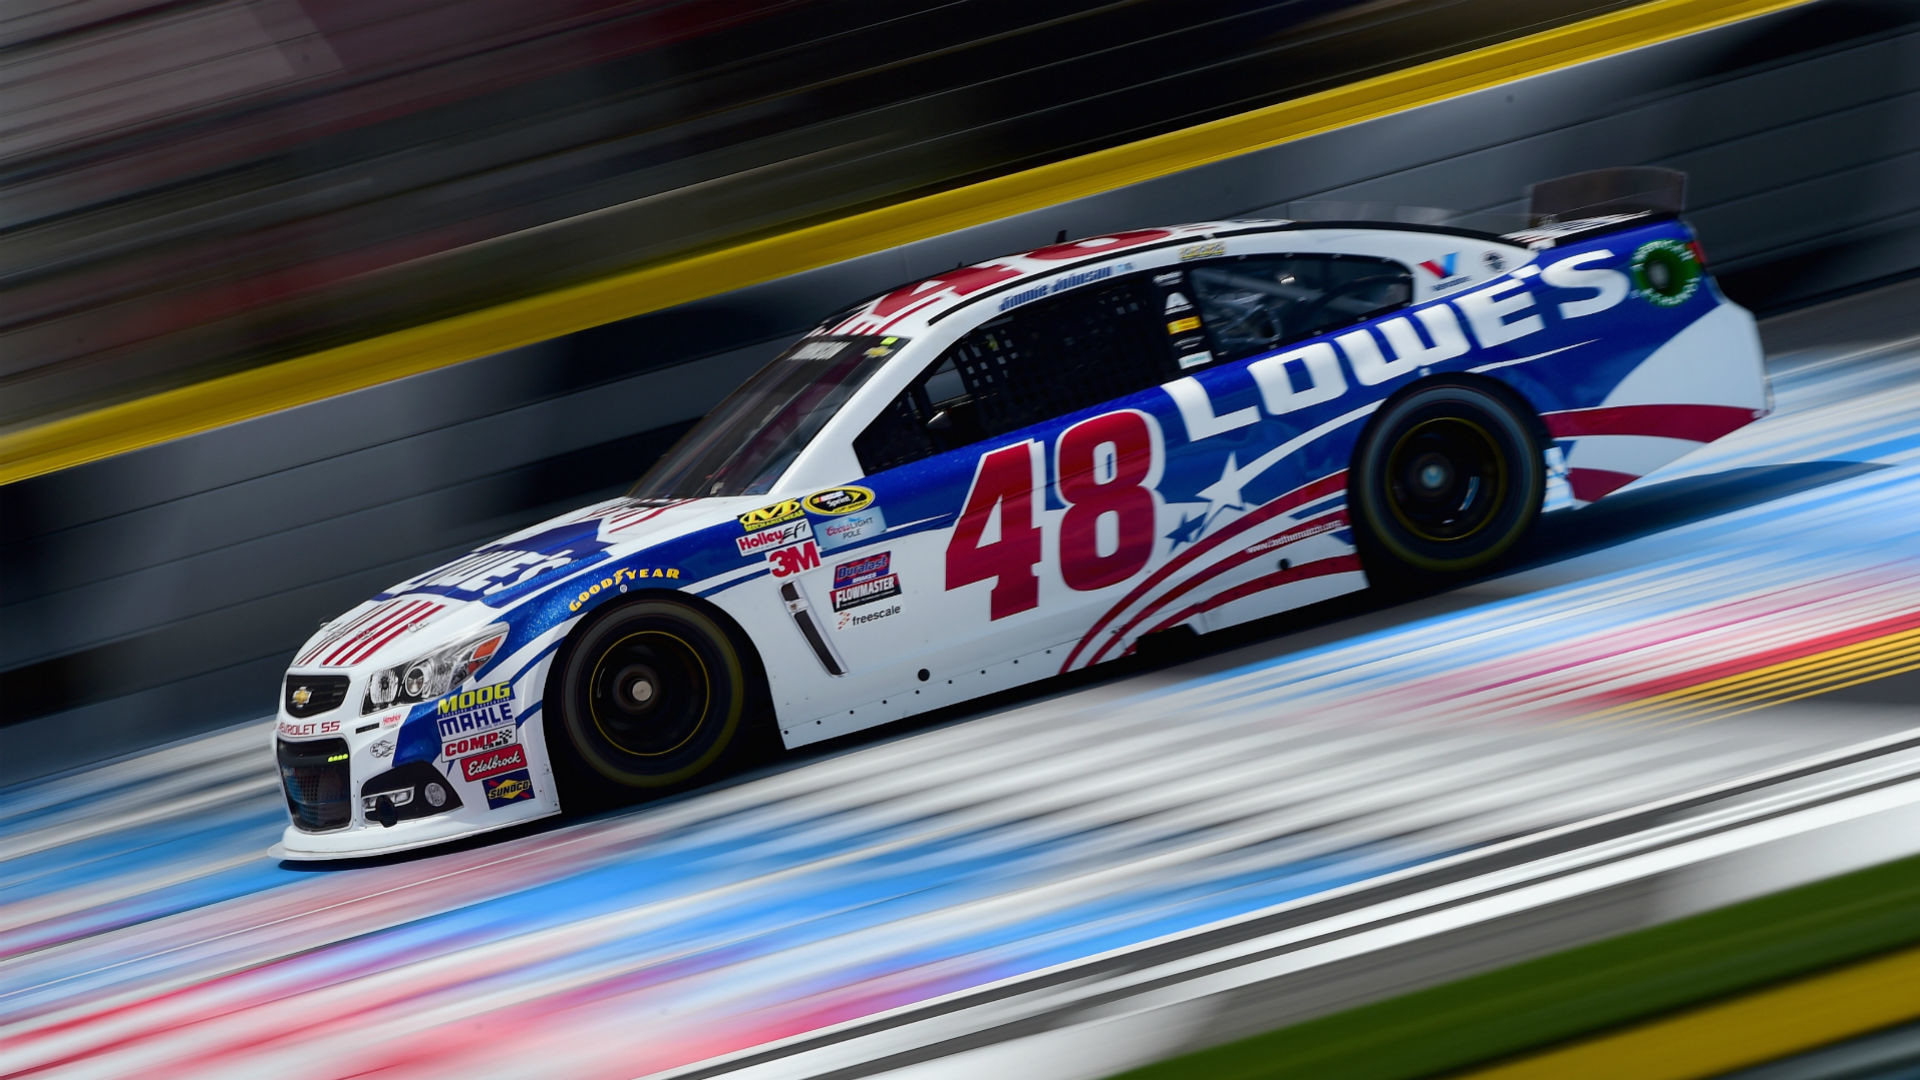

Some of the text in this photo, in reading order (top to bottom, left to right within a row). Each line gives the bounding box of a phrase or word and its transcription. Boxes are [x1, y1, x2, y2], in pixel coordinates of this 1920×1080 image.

[1160, 249, 1631, 442] LOWE'S
[945, 409, 1160, 622] 48
[843, 529, 861, 540] POLE
[769, 541, 821, 578] 3M
[837, 555, 888, 579] Duralast
[835, 576, 895, 609] FLOWMASTER
[852, 605, 901, 626] freescale
[437, 681, 511, 715] MOOG
[321, 720, 340, 733] SS
[438, 702, 514, 737] MAHLE
[445, 732, 499, 757] COMP
[482, 739, 509, 750] CAMS
[468, 750, 522, 776] Edelbrock
[488, 780, 530, 799] SUNOCO
